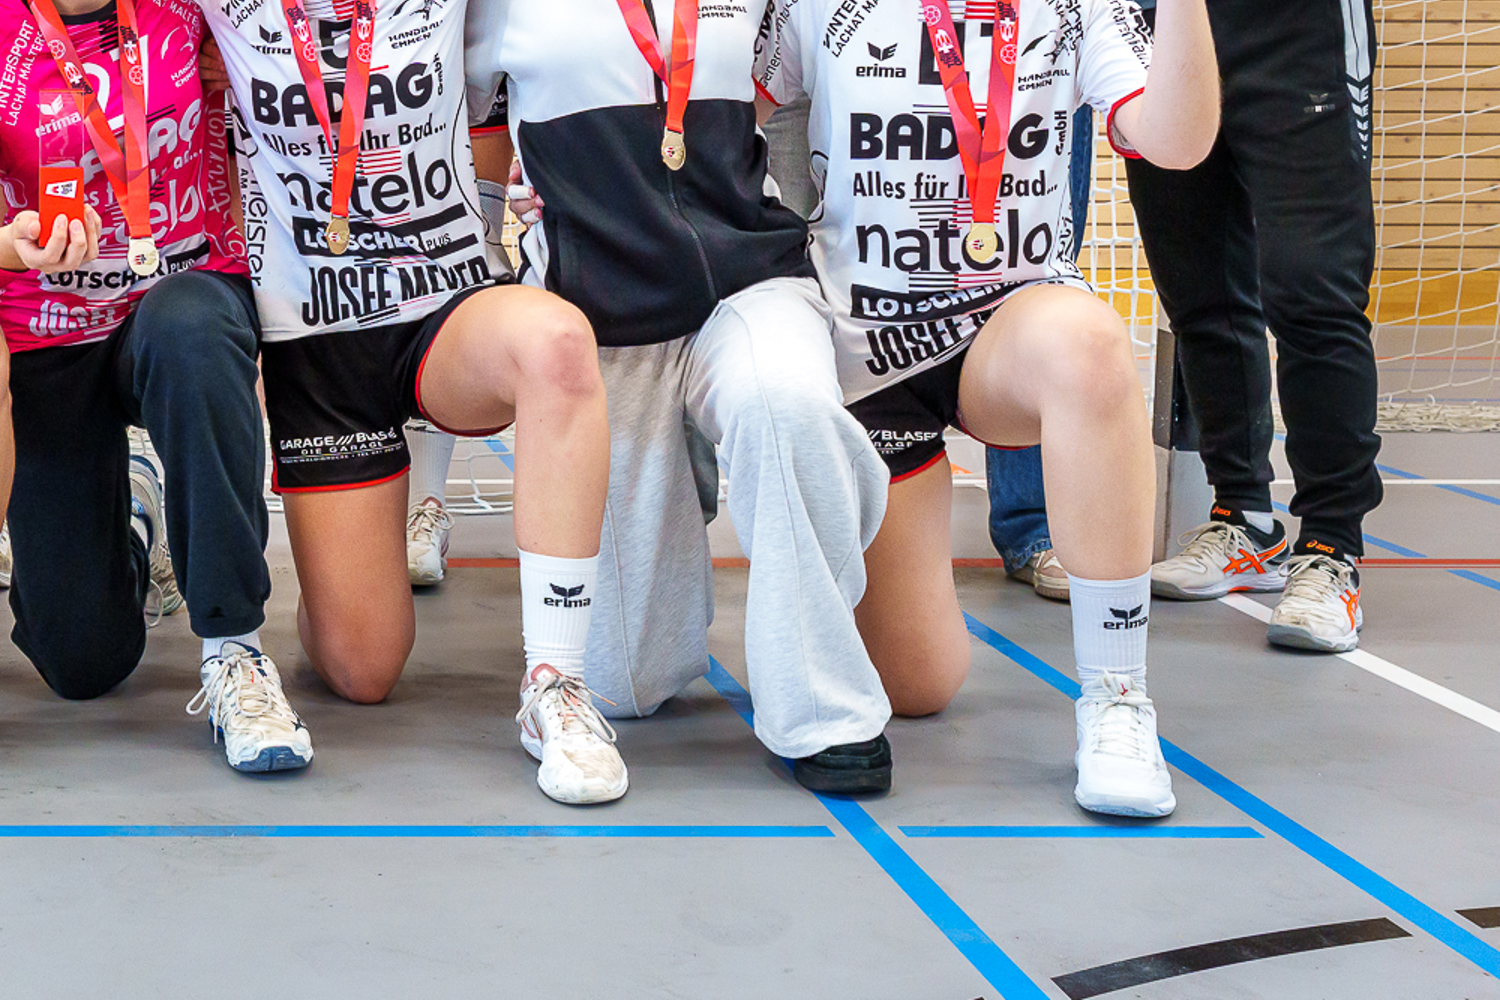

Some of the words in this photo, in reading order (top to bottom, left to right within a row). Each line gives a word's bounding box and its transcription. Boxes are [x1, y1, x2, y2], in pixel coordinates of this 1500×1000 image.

[391, 32, 432, 49] EMMEN
[832, 11, 868, 58] LACHAT
[856, 64, 907, 78] erima
[5, 80, 27, 127] LACHAT
[35, 111, 82, 138] erima
[399, 113, 447, 146] Bad...
[850, 112, 1049, 161] BADG
[853, 171, 906, 199] Alles
[914, 172, 949, 200] für
[1000, 169, 1058, 198] Bad...
[426, 233, 452, 250] PLUS
[302, 265, 393, 327] JOSEF
[865, 317, 962, 377] JOSEF
[301, 447, 322, 455] DIE
[544, 597, 591, 608] erima
[1103, 616, 1148, 630] erima
